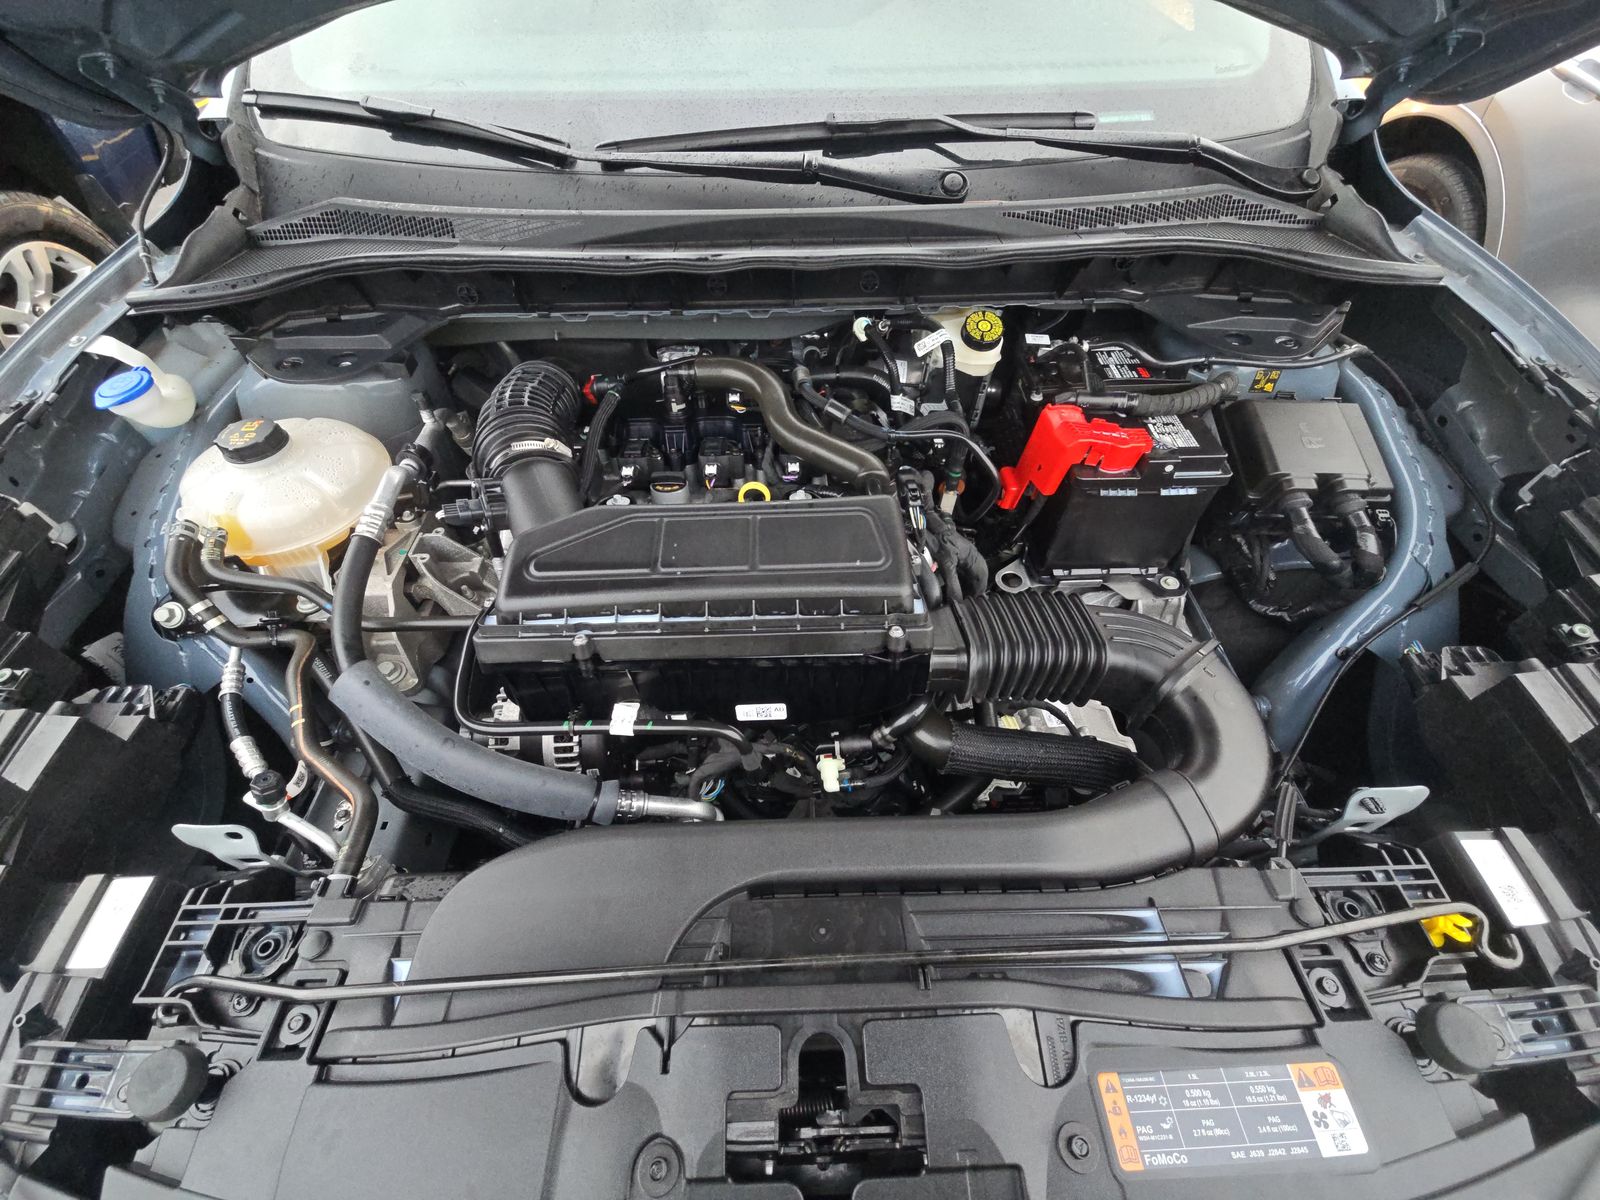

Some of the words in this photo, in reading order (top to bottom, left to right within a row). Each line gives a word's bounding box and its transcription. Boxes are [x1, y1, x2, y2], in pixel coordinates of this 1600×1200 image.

[1185, 1088, 1202, 1098] 0.500
[1202, 1088, 1212, 1099] kg
[1249, 1084, 1266, 1094] 0.550
[1266, 1084, 1276, 1094] kg
[1126, 1093, 1157, 1105] R-1234yf
[1201, 1119, 1215, 1127] PAG
[1267, 1115, 1281, 1124] PAG
[1136, 1125, 1154, 1135] PAG
[1230, 1150, 1246, 1159] SAE
[1249, 1149, 1265, 1158] J639
[1268, 1148, 1286, 1157] J2842
[1290, 1147, 1309, 1155] J2845
[1144, 1153, 1189, 1166] FoMoCo
